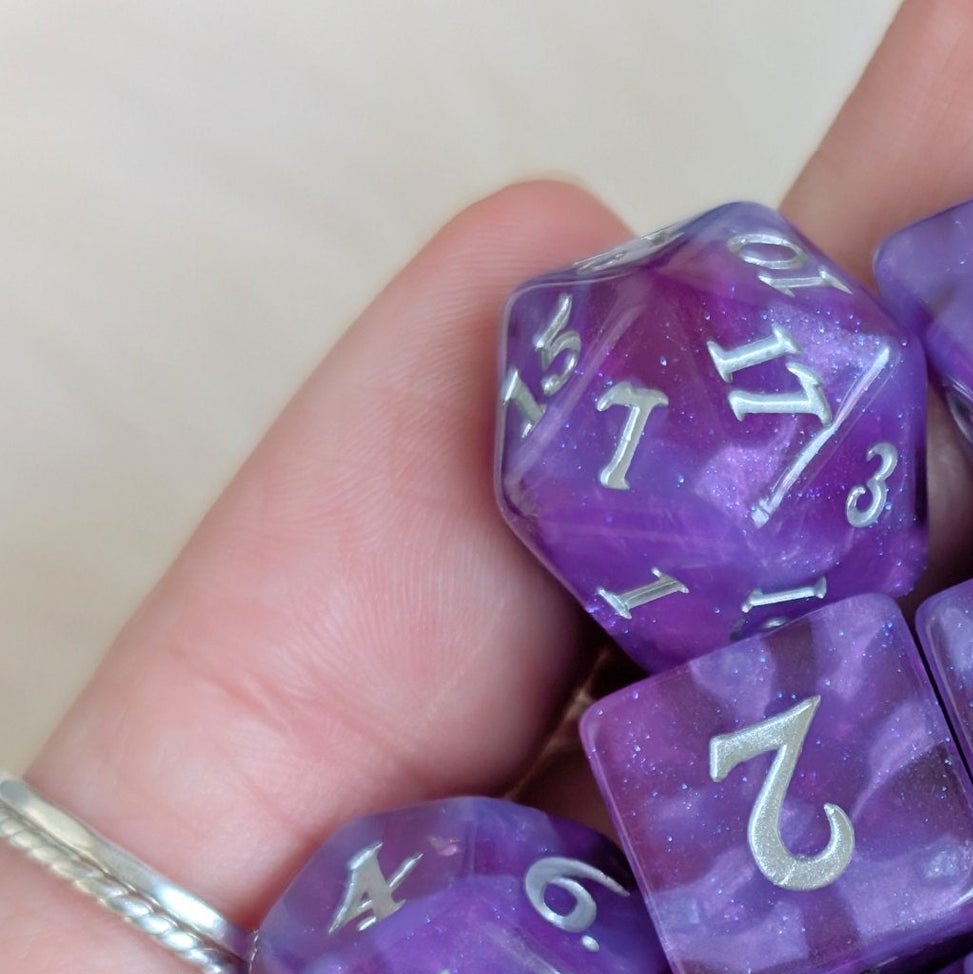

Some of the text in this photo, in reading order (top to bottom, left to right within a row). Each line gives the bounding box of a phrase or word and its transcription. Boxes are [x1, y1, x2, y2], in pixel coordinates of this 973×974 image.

[726, 232, 854, 298] 10
[502, 293, 582, 439] 15
[706, 324, 834, 427] 17
[596, 381, 670, 490] 7
[846, 442, 899, 528] 3
[598, 568, 690, 620] 1
[709, 695, 856, 891] 2
[328, 841, 425, 935] 4
